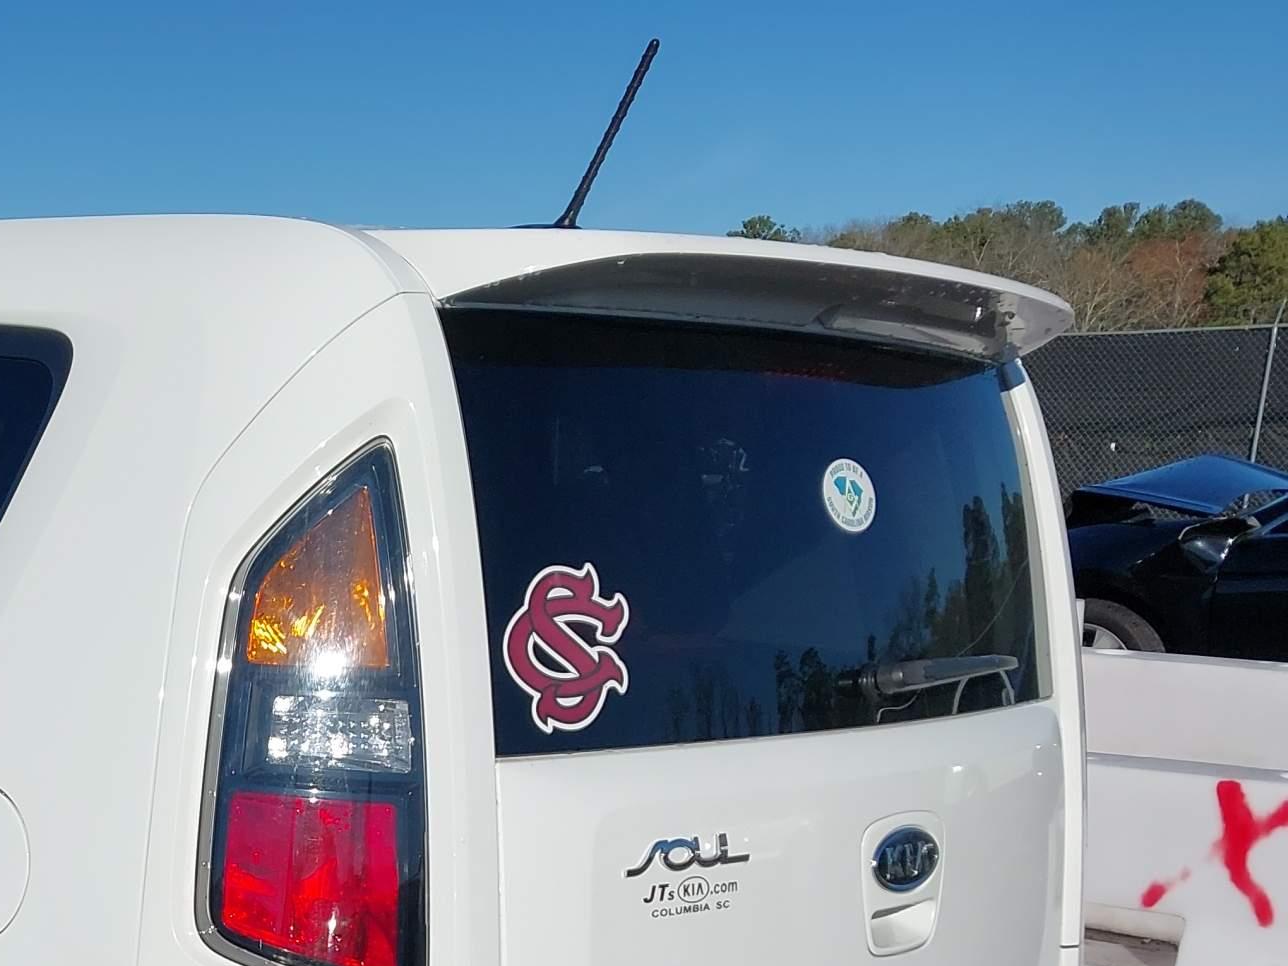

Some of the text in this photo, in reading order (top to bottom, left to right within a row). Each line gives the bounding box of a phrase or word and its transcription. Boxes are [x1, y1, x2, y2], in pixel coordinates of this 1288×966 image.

[623, 833, 750, 878] SOUL
[885, 840, 934, 880] KIA
[651, 899, 731, 918] COLUMBIA SC
